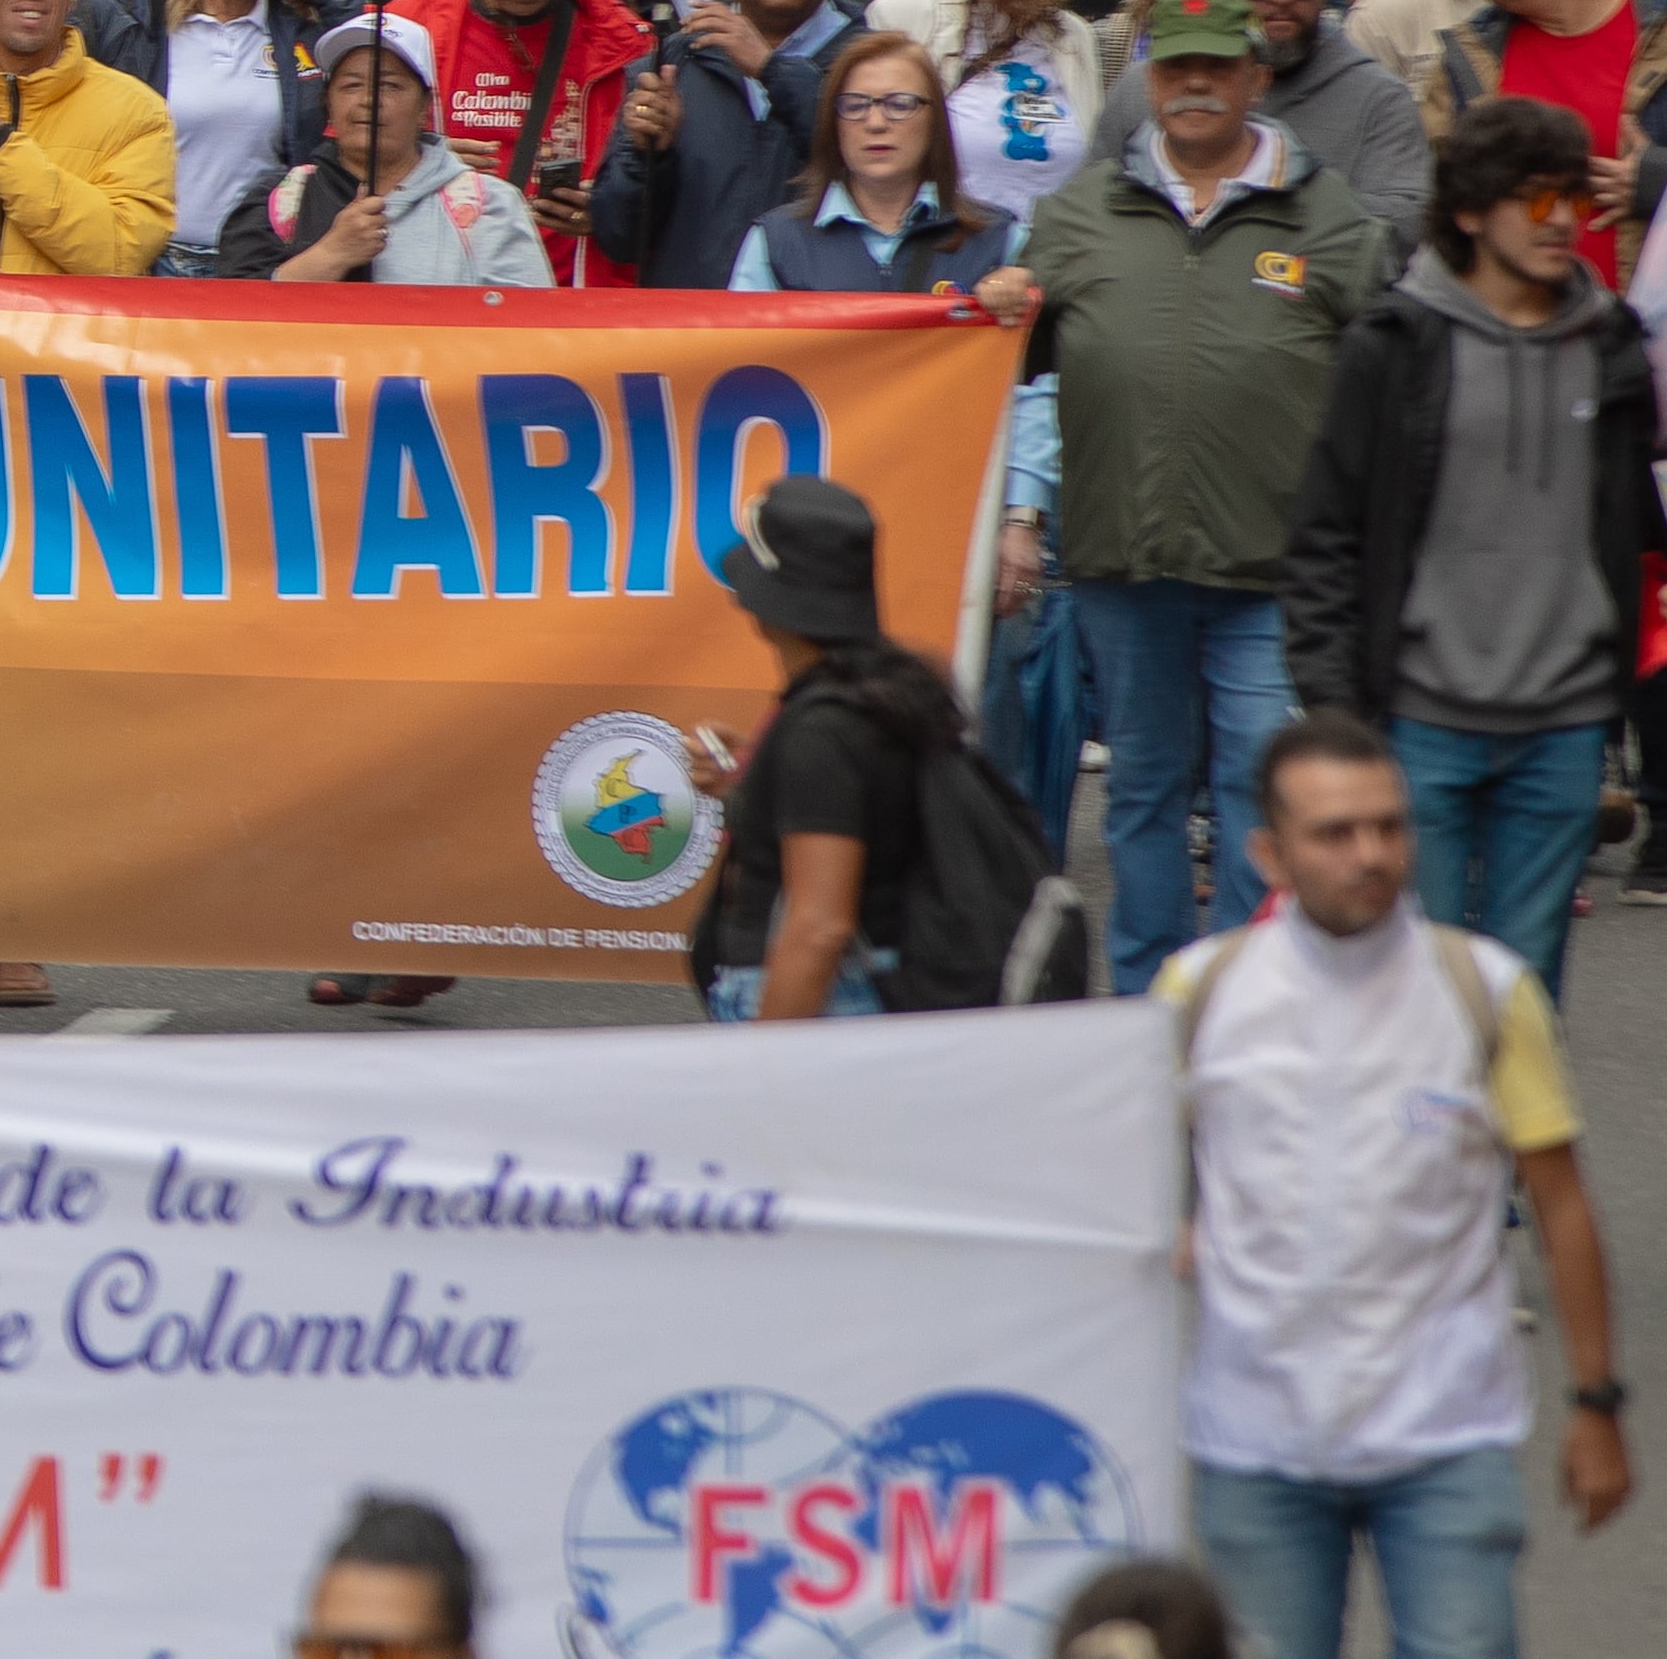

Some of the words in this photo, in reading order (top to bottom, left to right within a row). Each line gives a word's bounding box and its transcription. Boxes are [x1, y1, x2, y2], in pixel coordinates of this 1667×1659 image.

[451, 90, 533, 111] Colombi
[353, 920, 545, 947] CONFEDERACIÓN
[547, 928, 582, 949] DE
[149, 1144, 245, 1226] la
[287, 1138, 791, 1236] Industria
[64, 1248, 522, 1378] Colombia
[687, 1479, 1005, 1608] FSM
